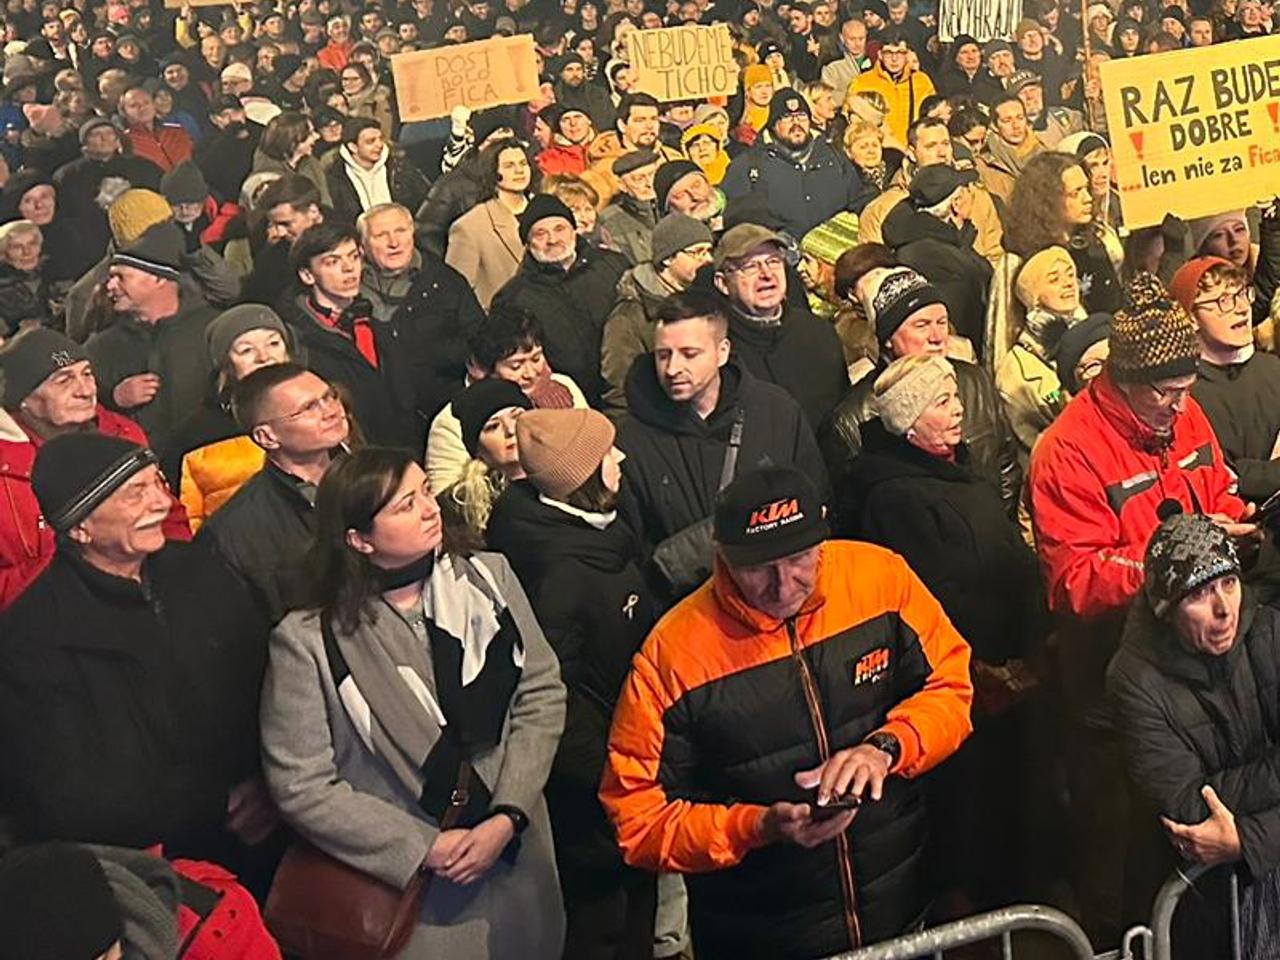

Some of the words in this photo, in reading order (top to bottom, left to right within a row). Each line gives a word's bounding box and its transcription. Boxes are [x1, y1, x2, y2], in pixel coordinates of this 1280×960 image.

[632, 26, 729, 69] NEBUDEME
[444, 84, 498, 111] FICA
[1120, 75, 1199, 128] RAZ
[1170, 110, 1252, 151] DOBRE
[1184, 157, 1214, 180] nie
[1221, 154, 1243, 173] za
[749, 499, 799, 526] KTM
